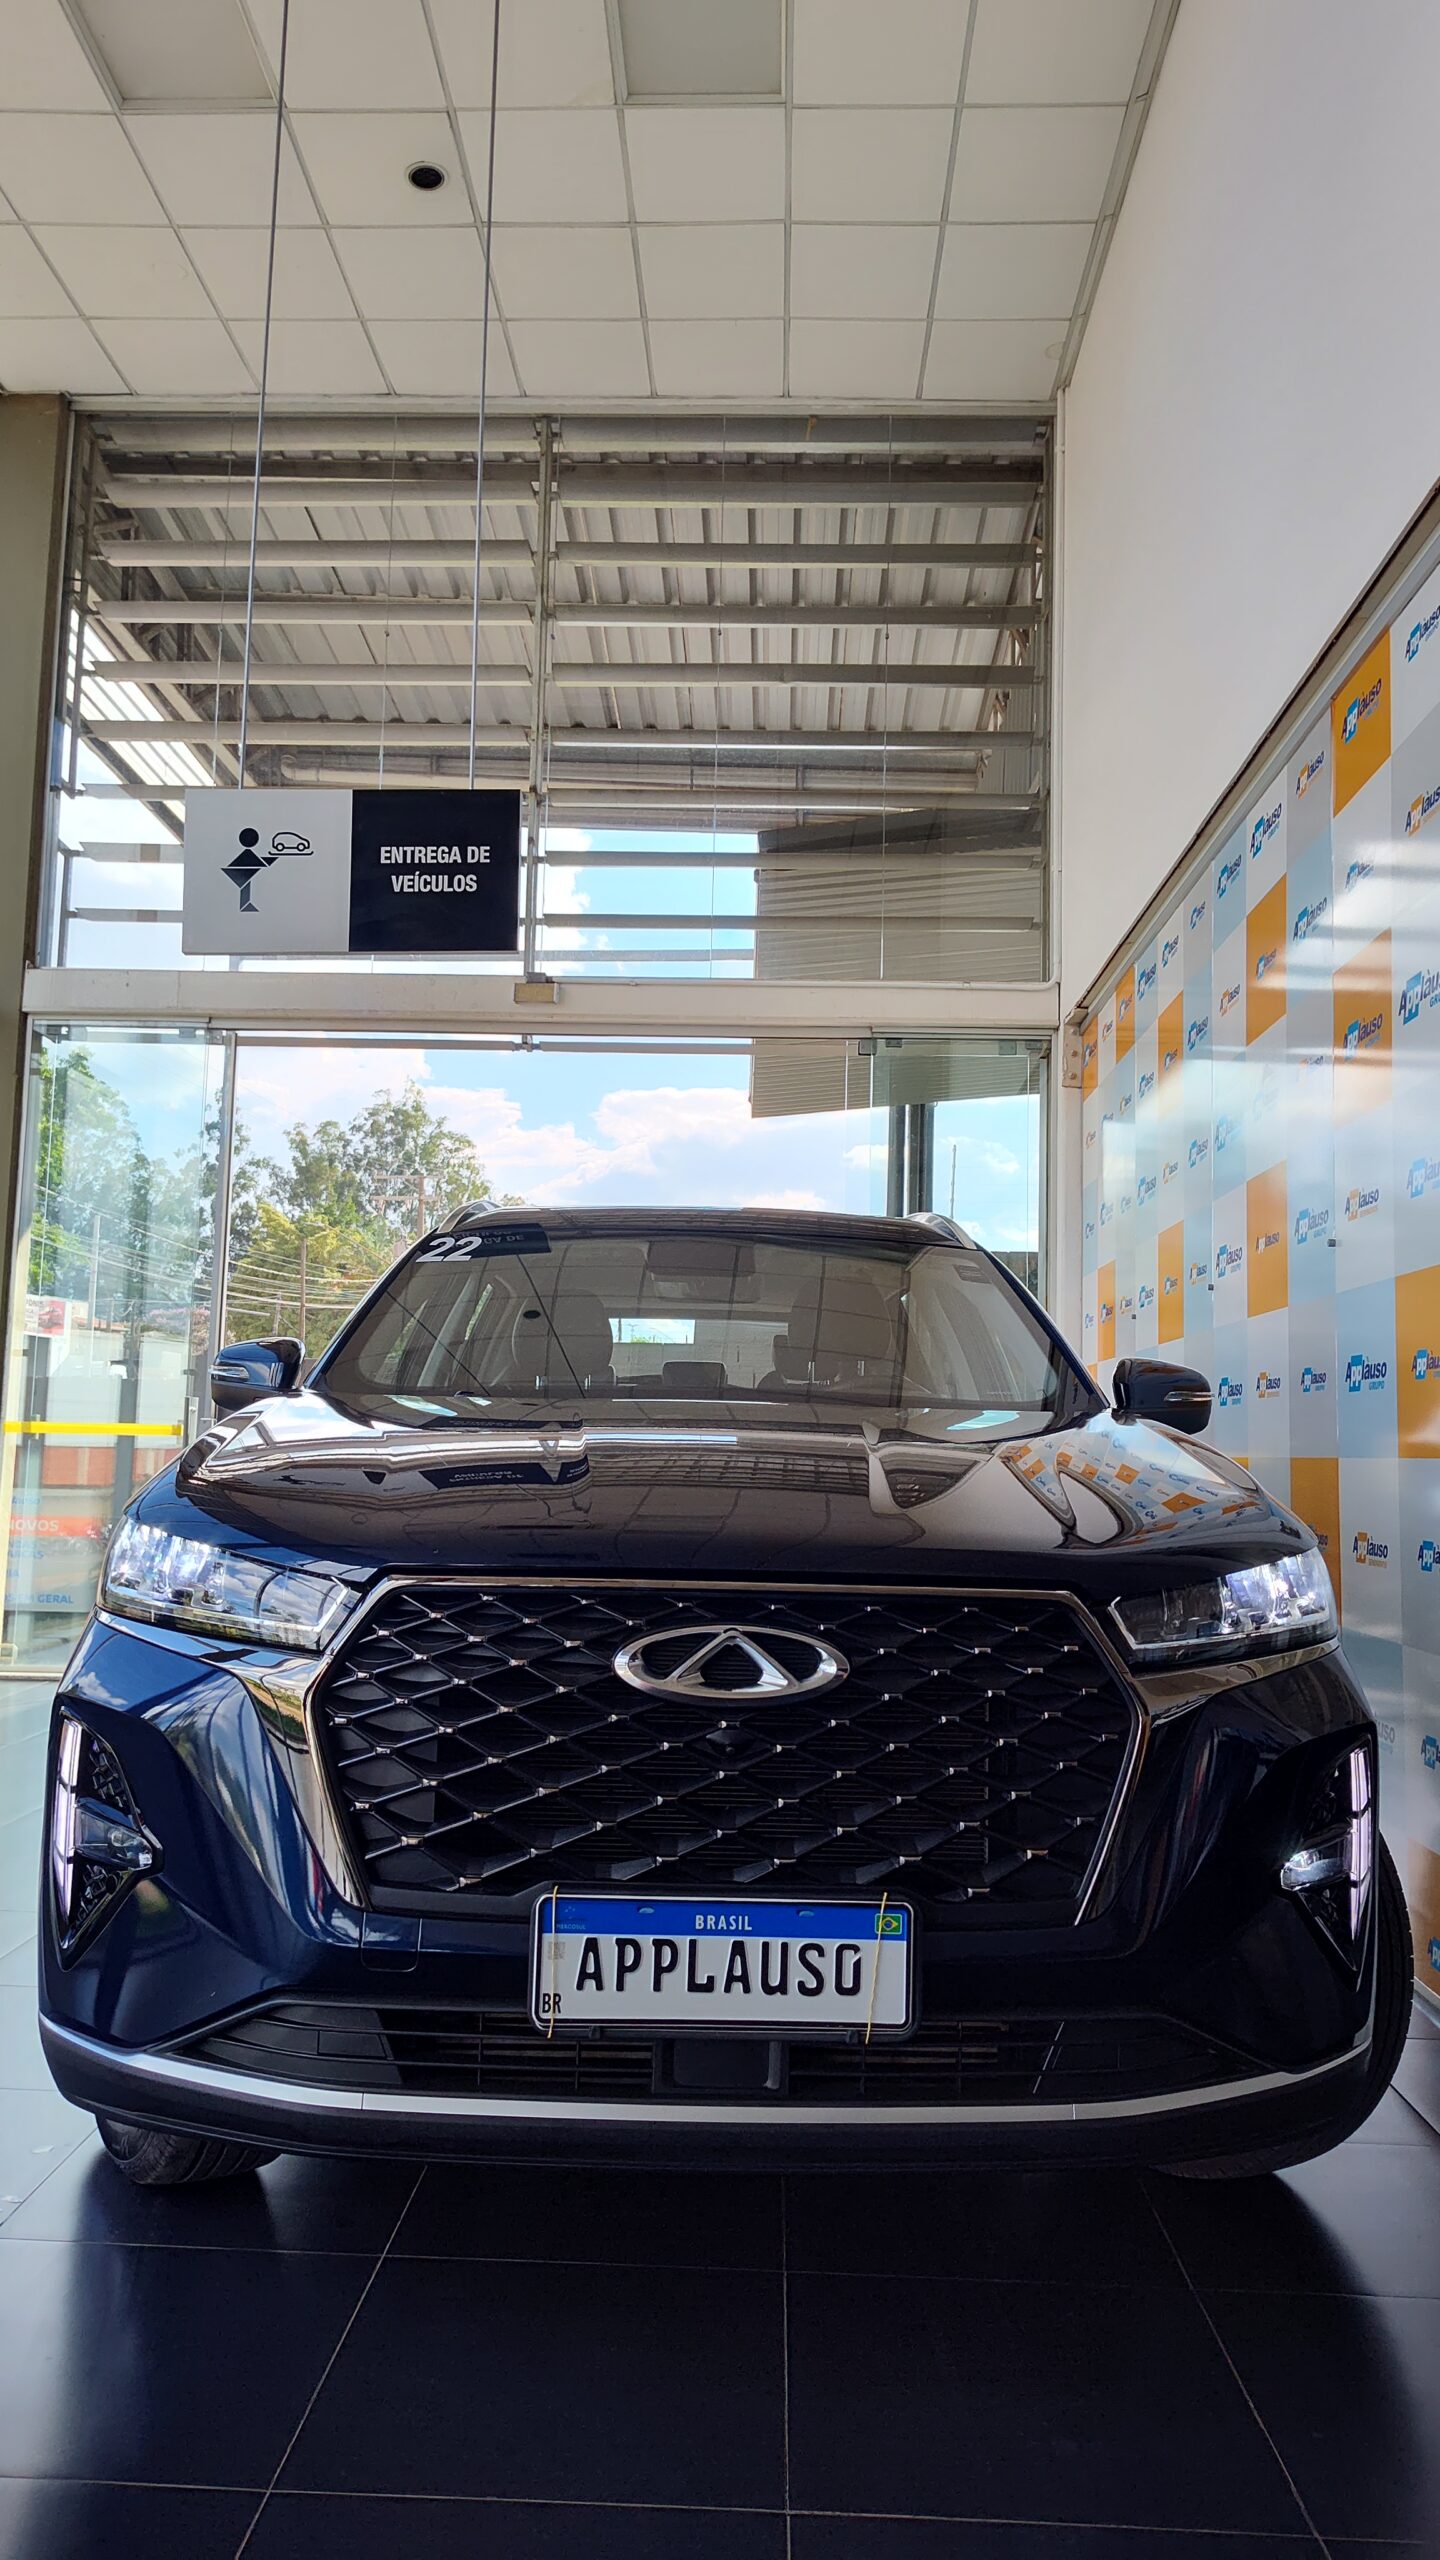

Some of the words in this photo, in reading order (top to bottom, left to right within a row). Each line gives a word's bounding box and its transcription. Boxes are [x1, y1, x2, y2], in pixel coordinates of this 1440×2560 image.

[380, 846, 461, 864] ENTREGA
[467, 846, 490, 863] DE
[391, 871, 477, 892] VEÍCULOS
[416, 1236, 482, 1263] 22
[38, 1594, 73, 1603] GERAL
[695, 1914, 752, 1931] BRASIL
[575, 1936, 862, 1998] APPLAUSO
[542, 1993, 562, 2014] BR
